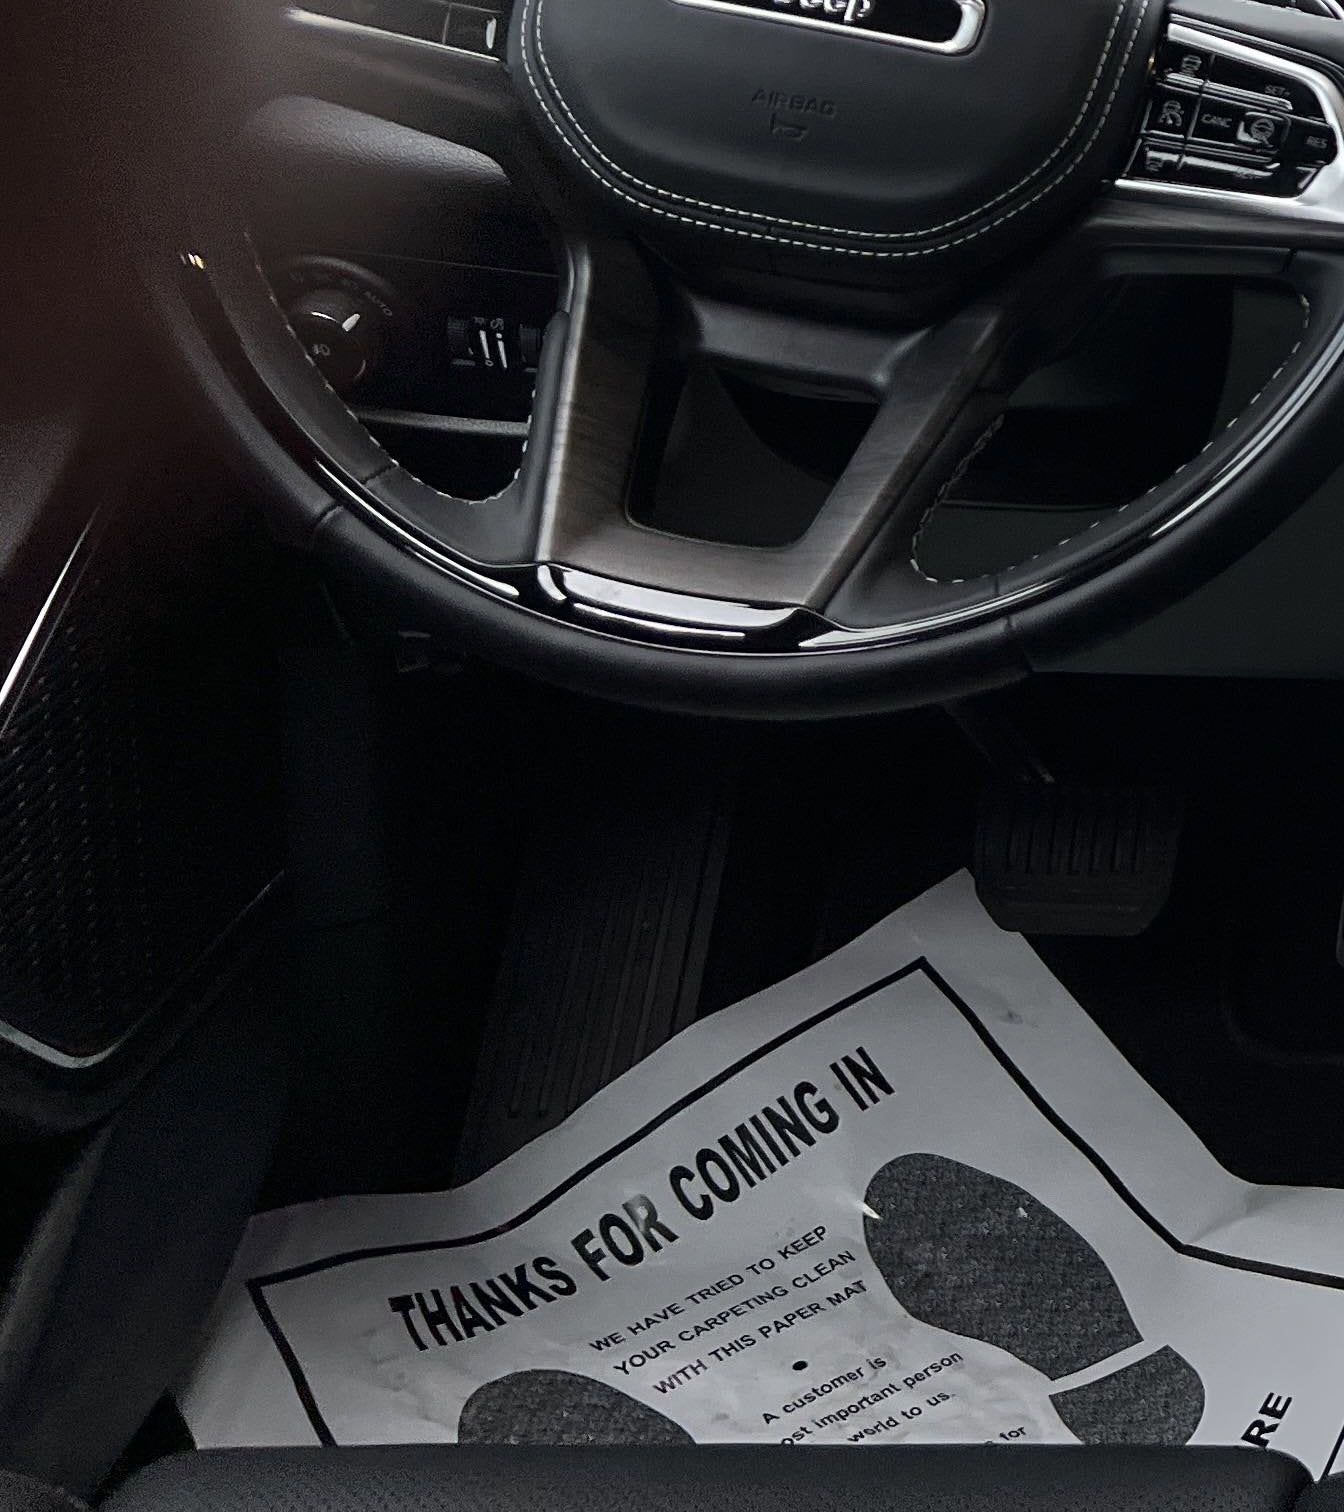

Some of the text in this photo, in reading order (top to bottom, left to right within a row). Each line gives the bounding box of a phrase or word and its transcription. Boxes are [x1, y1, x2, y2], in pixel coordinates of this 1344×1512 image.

[1200, 113, 1233, 128] CANC
[388, 1046, 896, 1352] THANKS FOR COMING IN
[589, 1225, 827, 1352] WE HAVE TRIED TO KEEP
[613, 1250, 856, 1376] YOUR CARPETING CLEAN
[652, 1279, 867, 1395] WITH THIS PAPER MAT
[762, 1356, 888, 1424] A customer is
[780, 1351, 964, 1446] ost important person
[846, 1416, 900, 1444] world
[900, 1405, 923, 1420] to
[999, 1425, 1027, 1441] for
